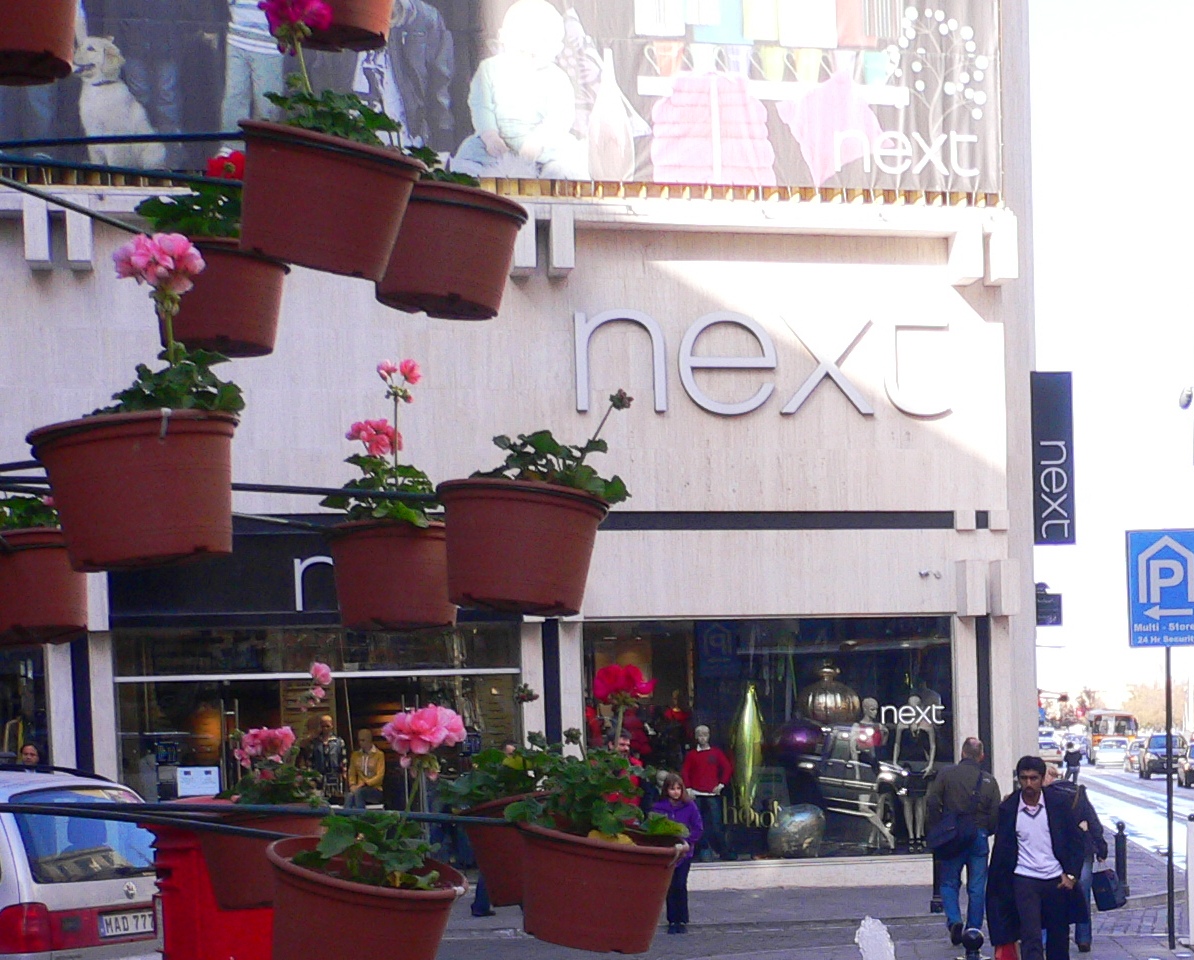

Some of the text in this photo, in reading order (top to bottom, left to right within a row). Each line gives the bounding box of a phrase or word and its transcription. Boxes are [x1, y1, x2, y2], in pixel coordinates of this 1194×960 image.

[834, 129, 979, 177] next
[574, 308, 953, 420] next
[1040, 441, 1070, 538] next
[1150, 559, 1184, 603] P
[1133, 622, 1160, 633] Multi
[880, 703, 945, 725] next
[104, 915, 130, 934] MAD
